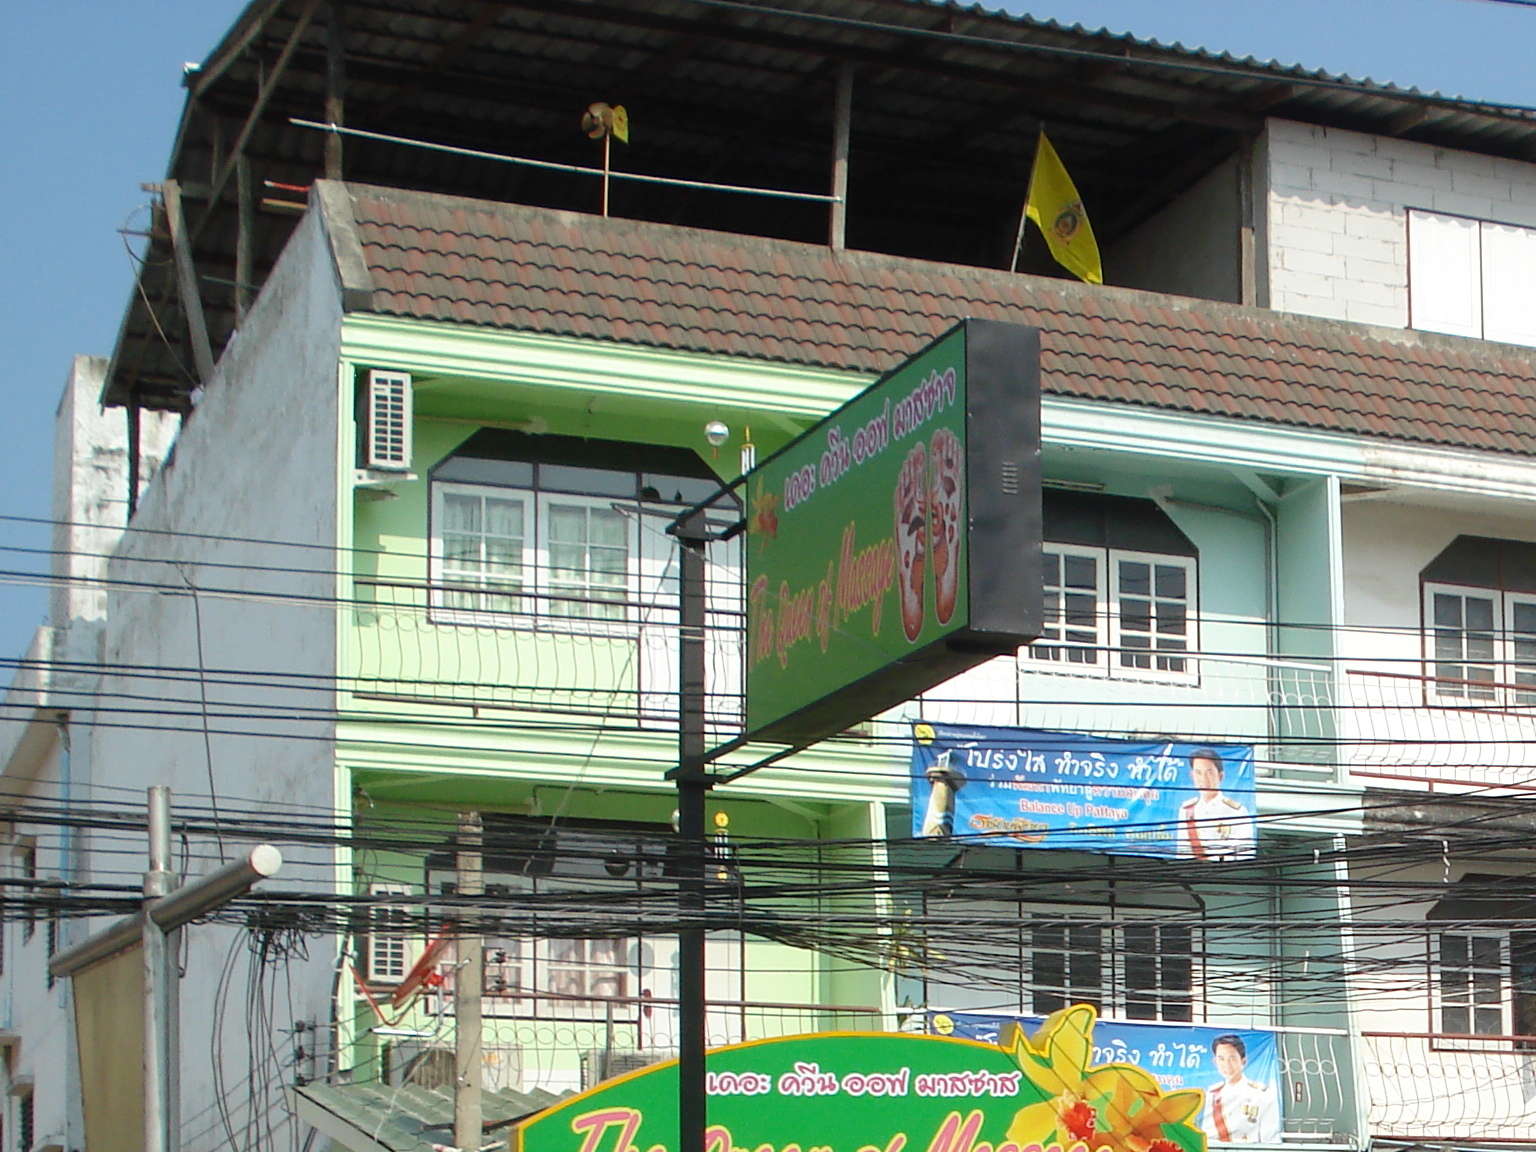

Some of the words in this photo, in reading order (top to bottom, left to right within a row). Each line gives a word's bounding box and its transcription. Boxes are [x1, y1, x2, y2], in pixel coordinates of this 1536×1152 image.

[750, 573, 774, 673] The
[776, 580, 814, 671] Queen
[816, 560, 833, 655] of
[834, 520, 895, 638] Massage
[1019, 798, 1065, 815] Balance
[1066, 801, 1083, 818] Up
[1085, 802, 1128, 820] Pattaya
[706, 1072, 771, 1097] เดอะ
[778, 1061, 840, 1097] ควีน
[843, 1066, 910, 1097] ออฟ
